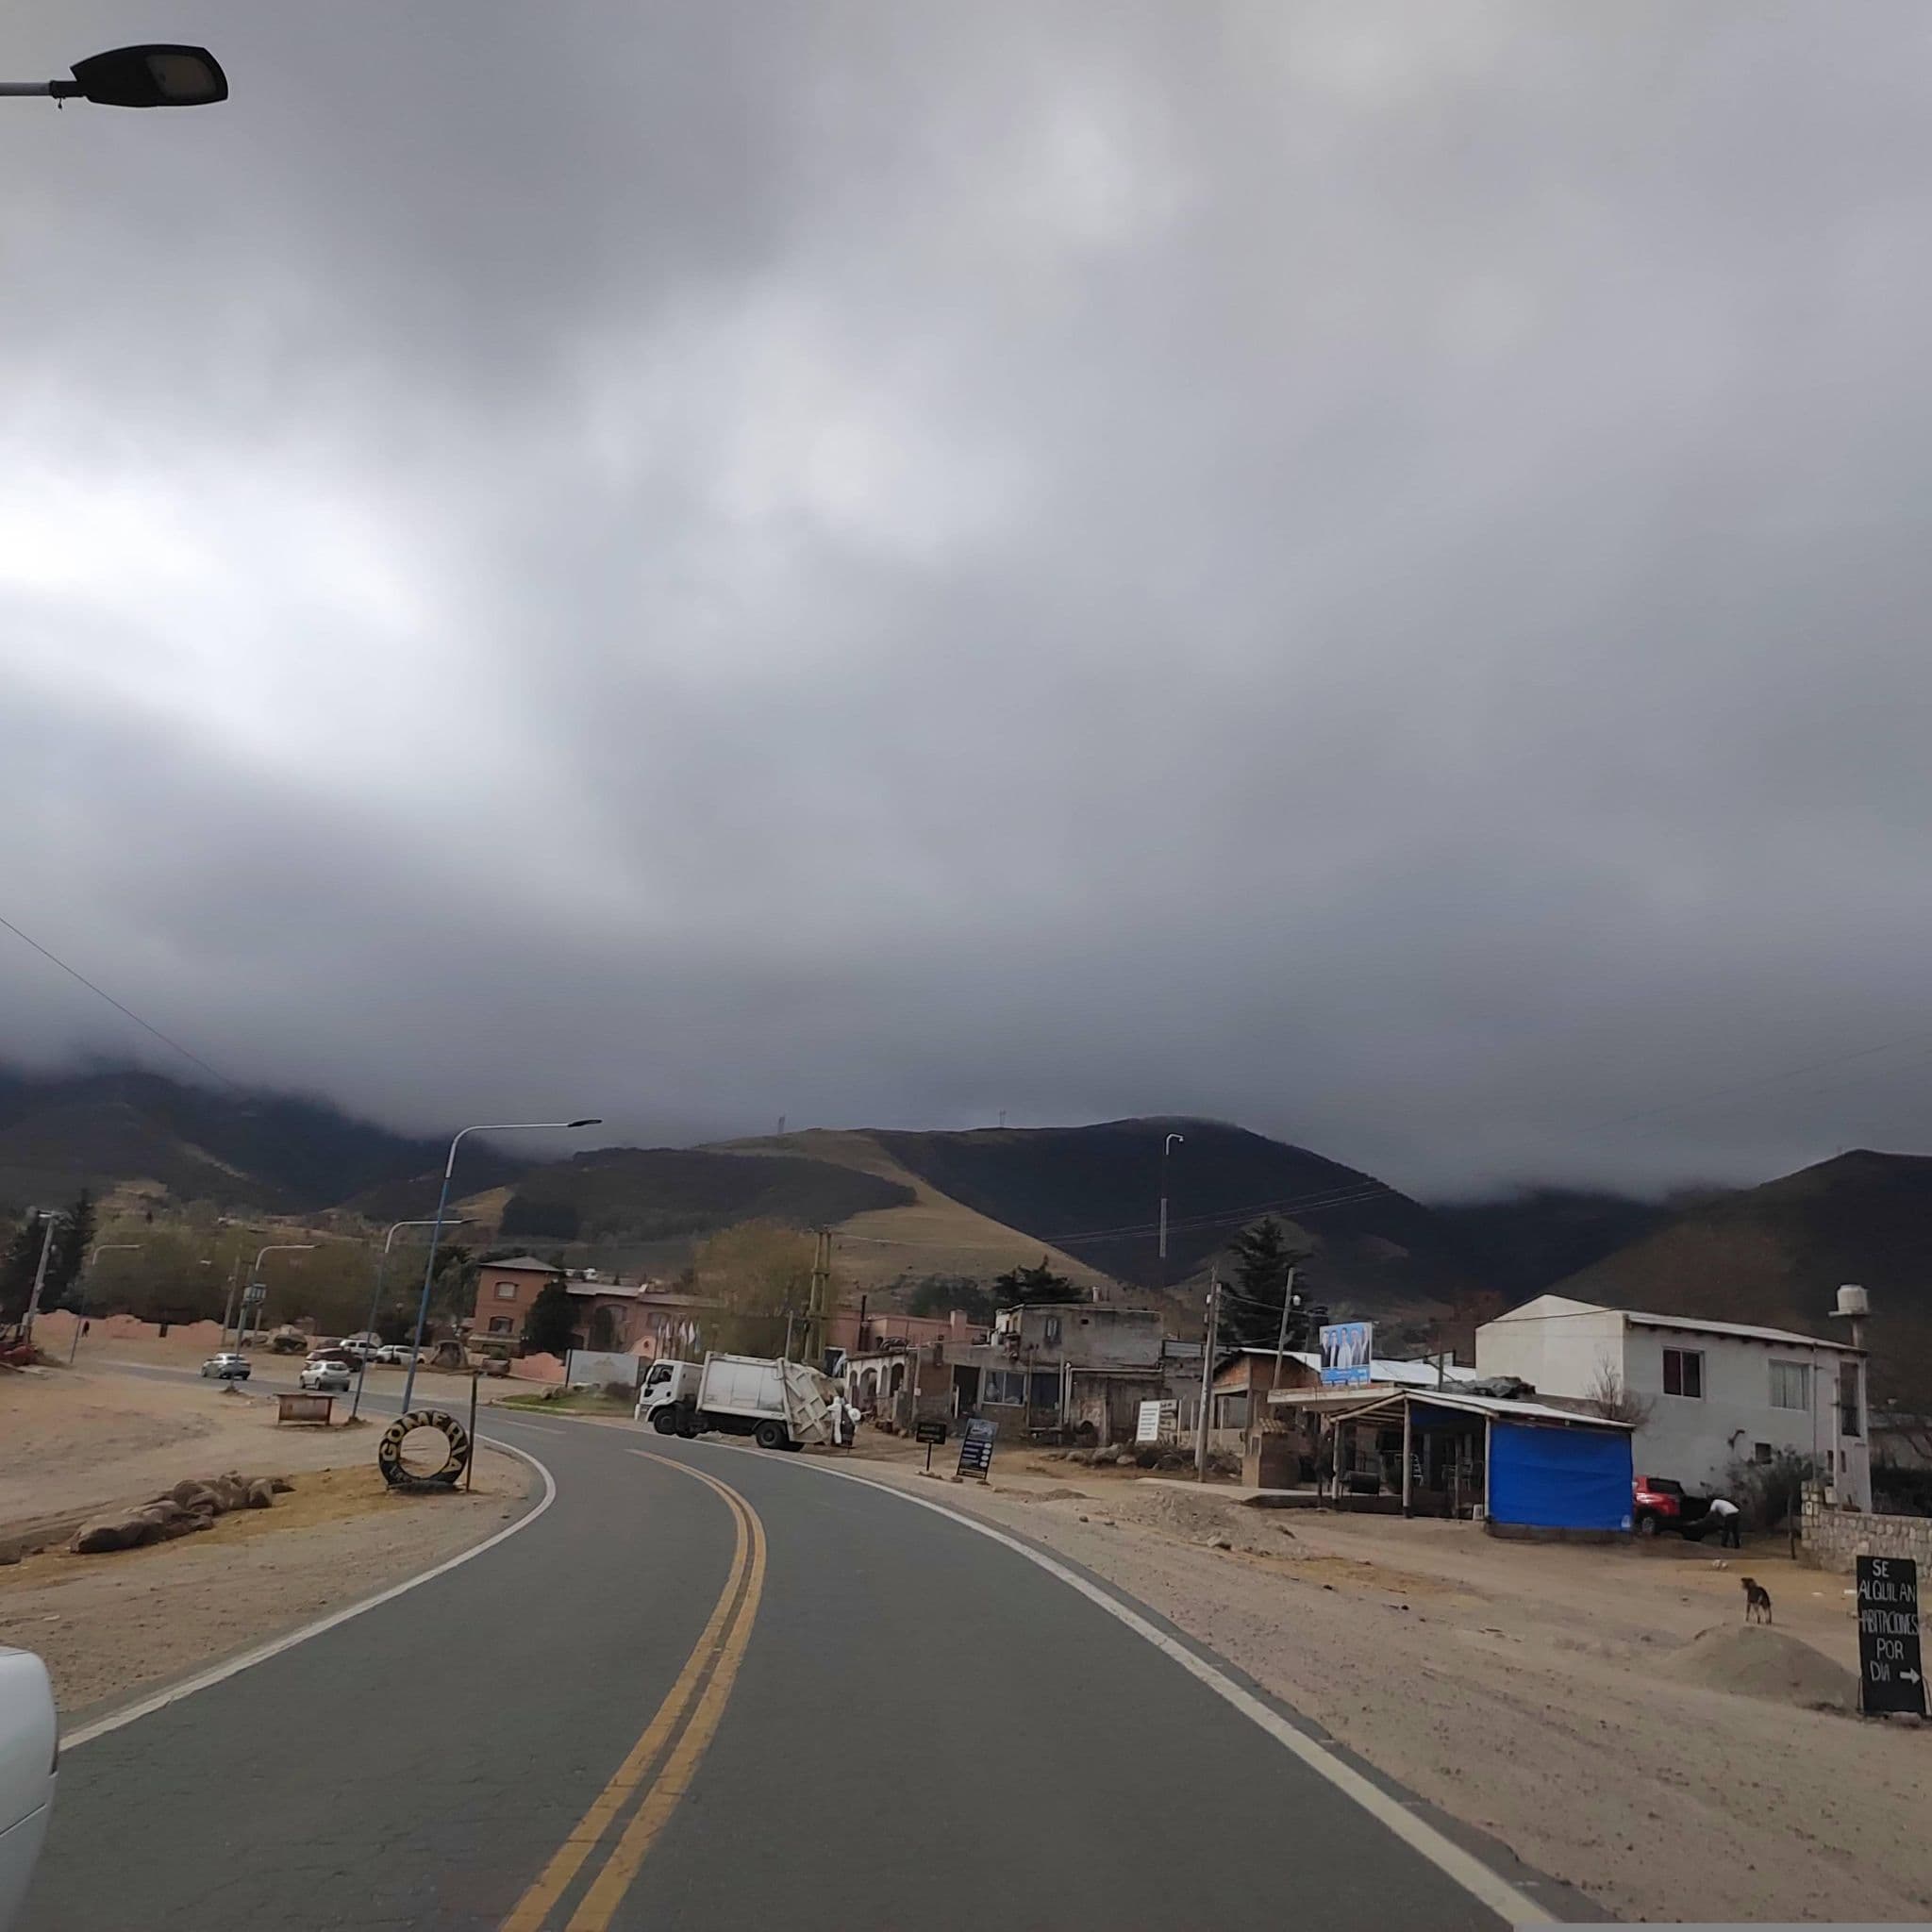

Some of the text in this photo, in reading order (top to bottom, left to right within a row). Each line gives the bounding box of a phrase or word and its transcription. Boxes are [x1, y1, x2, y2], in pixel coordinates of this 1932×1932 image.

[381, 1411, 468, 1473] GOMERIA
[1873, 1559, 1890, 1577] SE
[1858, 1579, 1916, 1603] ALQUILAN
[1876, 1638, 1904, 1660] POR
